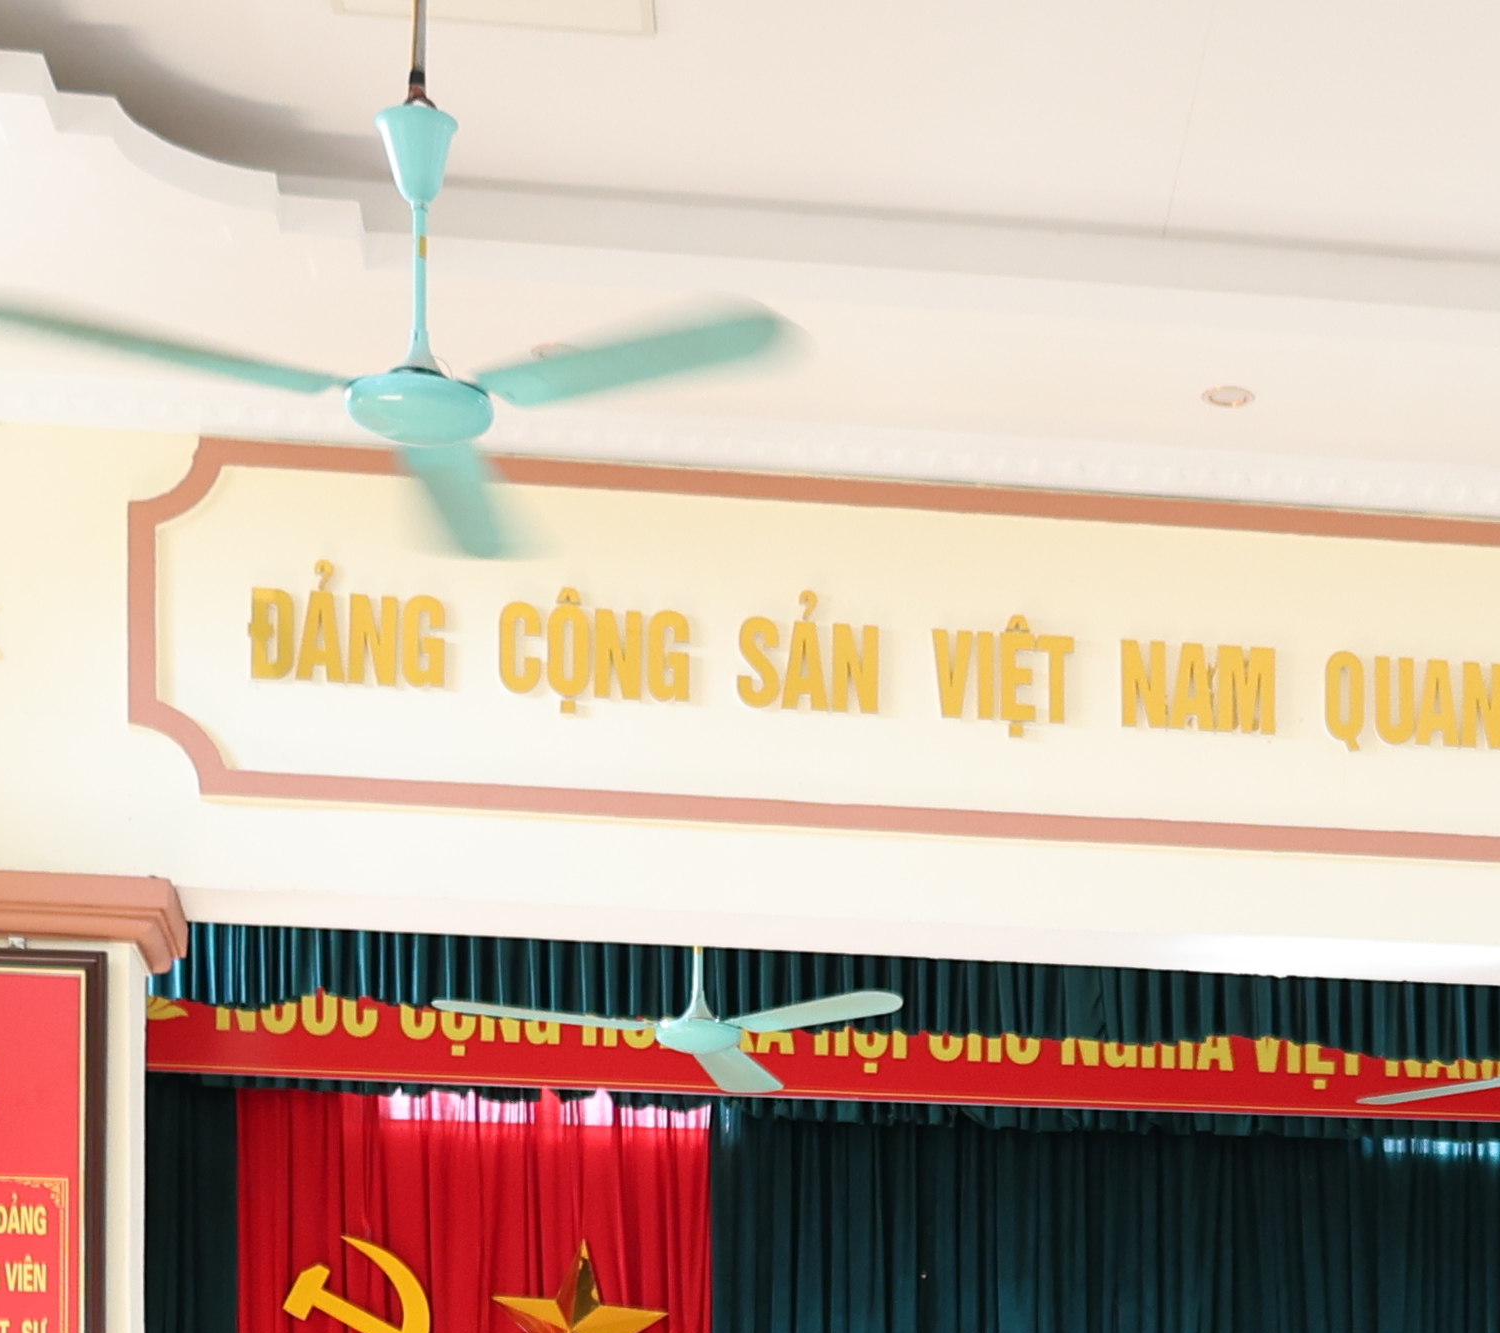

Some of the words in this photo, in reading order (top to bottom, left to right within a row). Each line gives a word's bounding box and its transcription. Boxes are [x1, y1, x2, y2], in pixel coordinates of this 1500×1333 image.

[248, 559, 446, 688] ĐẢNG
[499, 586, 690, 714] CỘNG
[737, 590, 881, 714] SẢN
[932, 614, 1075, 738] VIỆT
[1120, 639, 1277, 735] NAM
[4, 1254, 47, 1292] VIÊN
